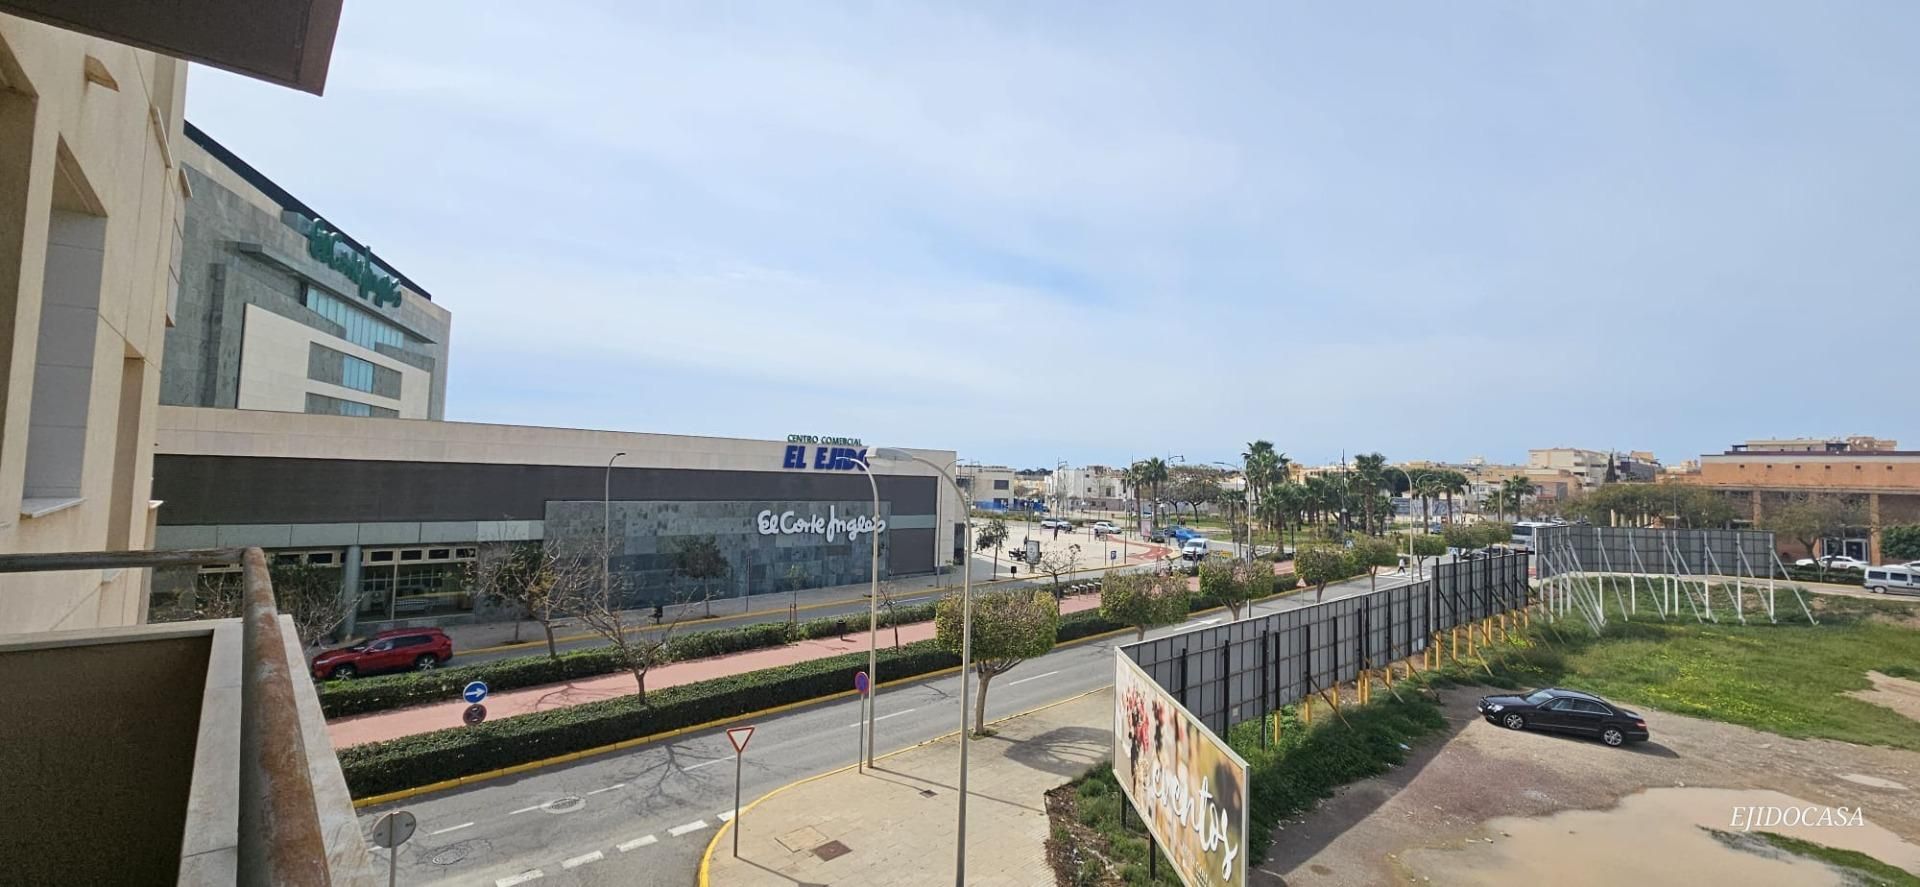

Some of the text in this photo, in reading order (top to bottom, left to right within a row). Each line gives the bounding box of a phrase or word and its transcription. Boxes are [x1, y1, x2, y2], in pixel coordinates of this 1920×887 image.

[787, 434, 863, 447] CENTRO COMERCIAL
[783, 445, 806, 469] EL
[758, 509, 779, 535] El
[780, 510, 825, 534] Corte
